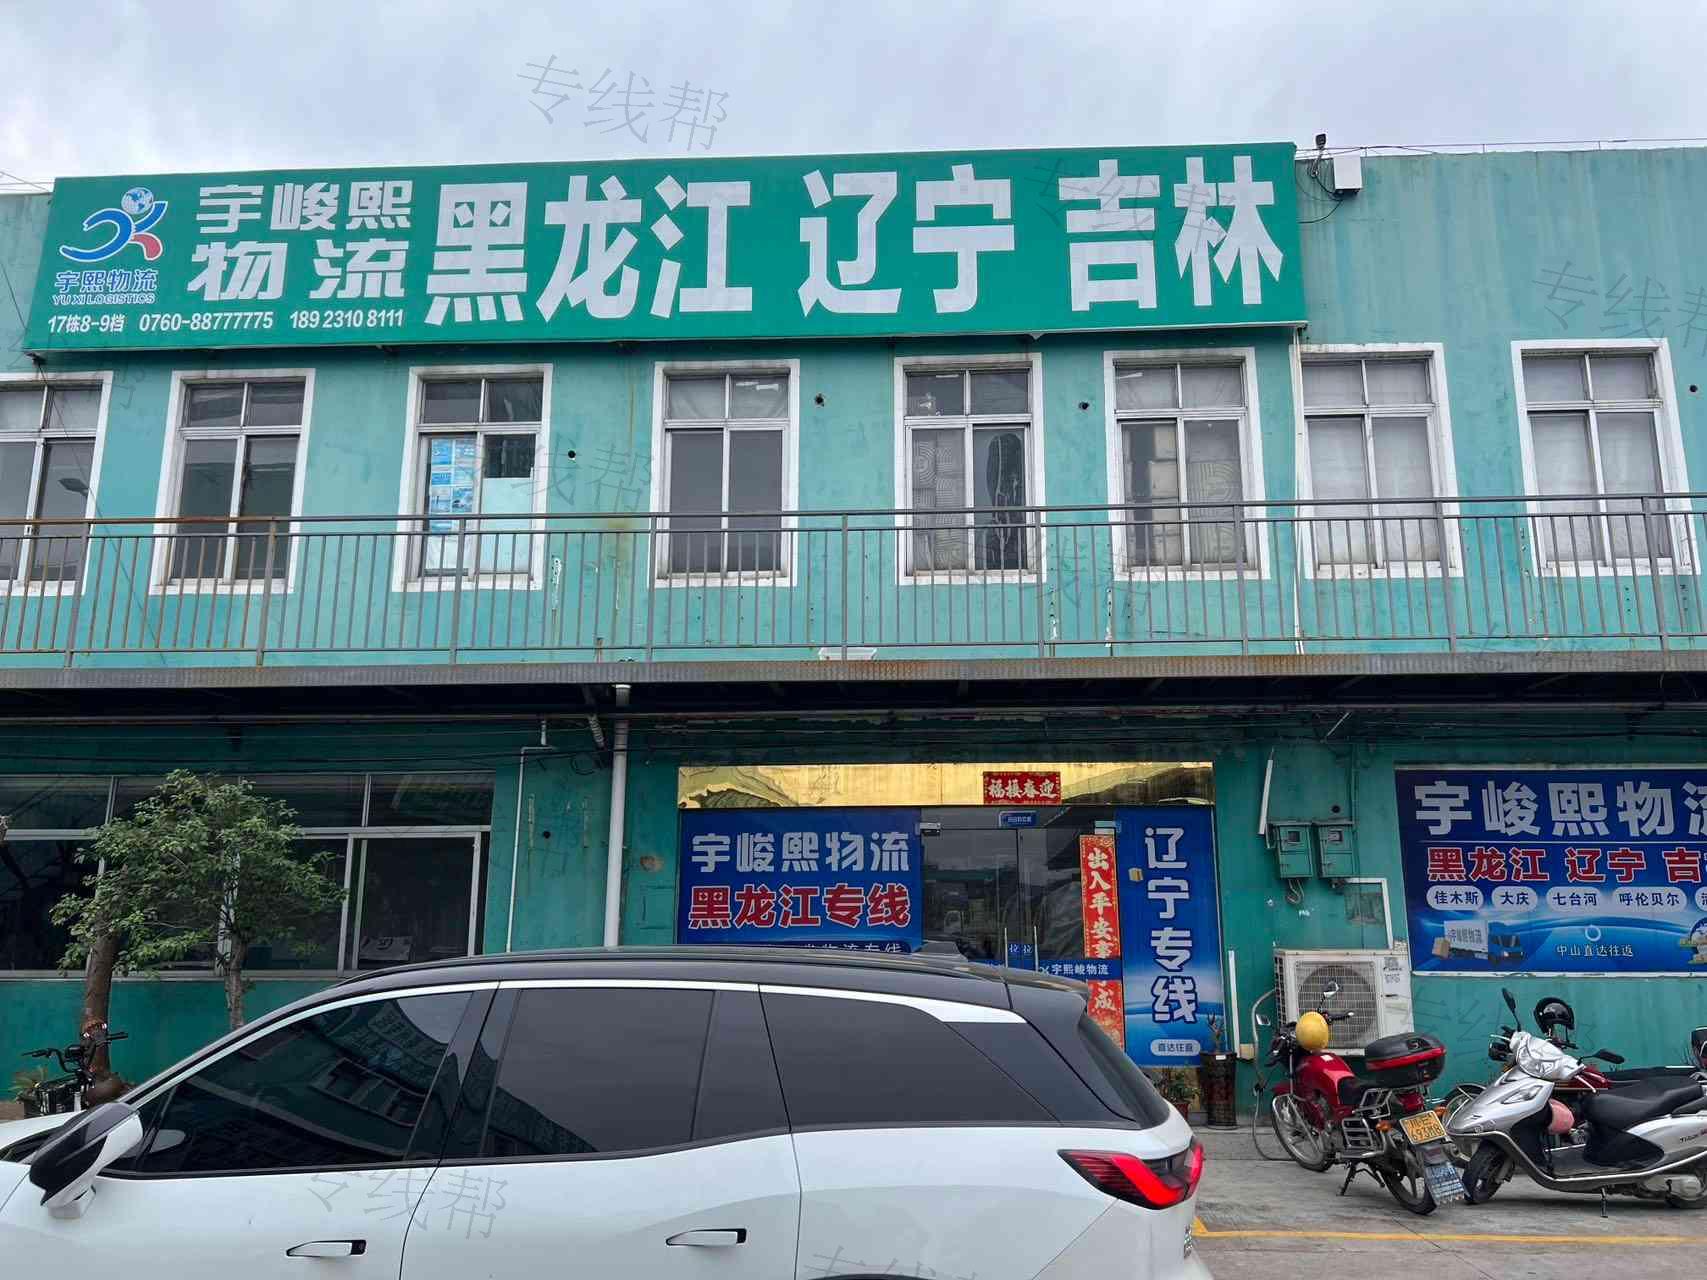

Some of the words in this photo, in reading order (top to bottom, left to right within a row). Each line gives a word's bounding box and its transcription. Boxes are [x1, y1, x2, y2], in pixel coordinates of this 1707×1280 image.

[198, 180, 413, 234] 宇峻熙
[424, 175, 753, 327] 黑龙江
[798, 163, 1016, 318] 辽宁
[1058, 155, 1285, 313] 吉林
[54, 269, 159, 293] 宇熙物流
[187, 238, 410, 302] 物流
[86, 292, 156, 305] LOGISTICS
[138, 311, 274, 332] 0760-88777775
[691, 830, 910, 873] 宇峻熙物流
[1427, 847, 1550, 883] 黑龙江
[1564, 847, 1647, 883] 辽宁
[688, 882, 911, 929] 黑龙江专线
[1434, 891, 1480, 906] 佳木斯
[1500, 892, 1530, 906] 大庆
[1552, 892, 1598, 907] 七台河
[1618, 891, 1681, 907] 呼伦贝尔
[1144, 827, 1199, 1024] 辽宁专线
[1556, 943, 1634, 957] 中山直达往返
[1051, 963, 1110, 976] 宇熙峻物流
